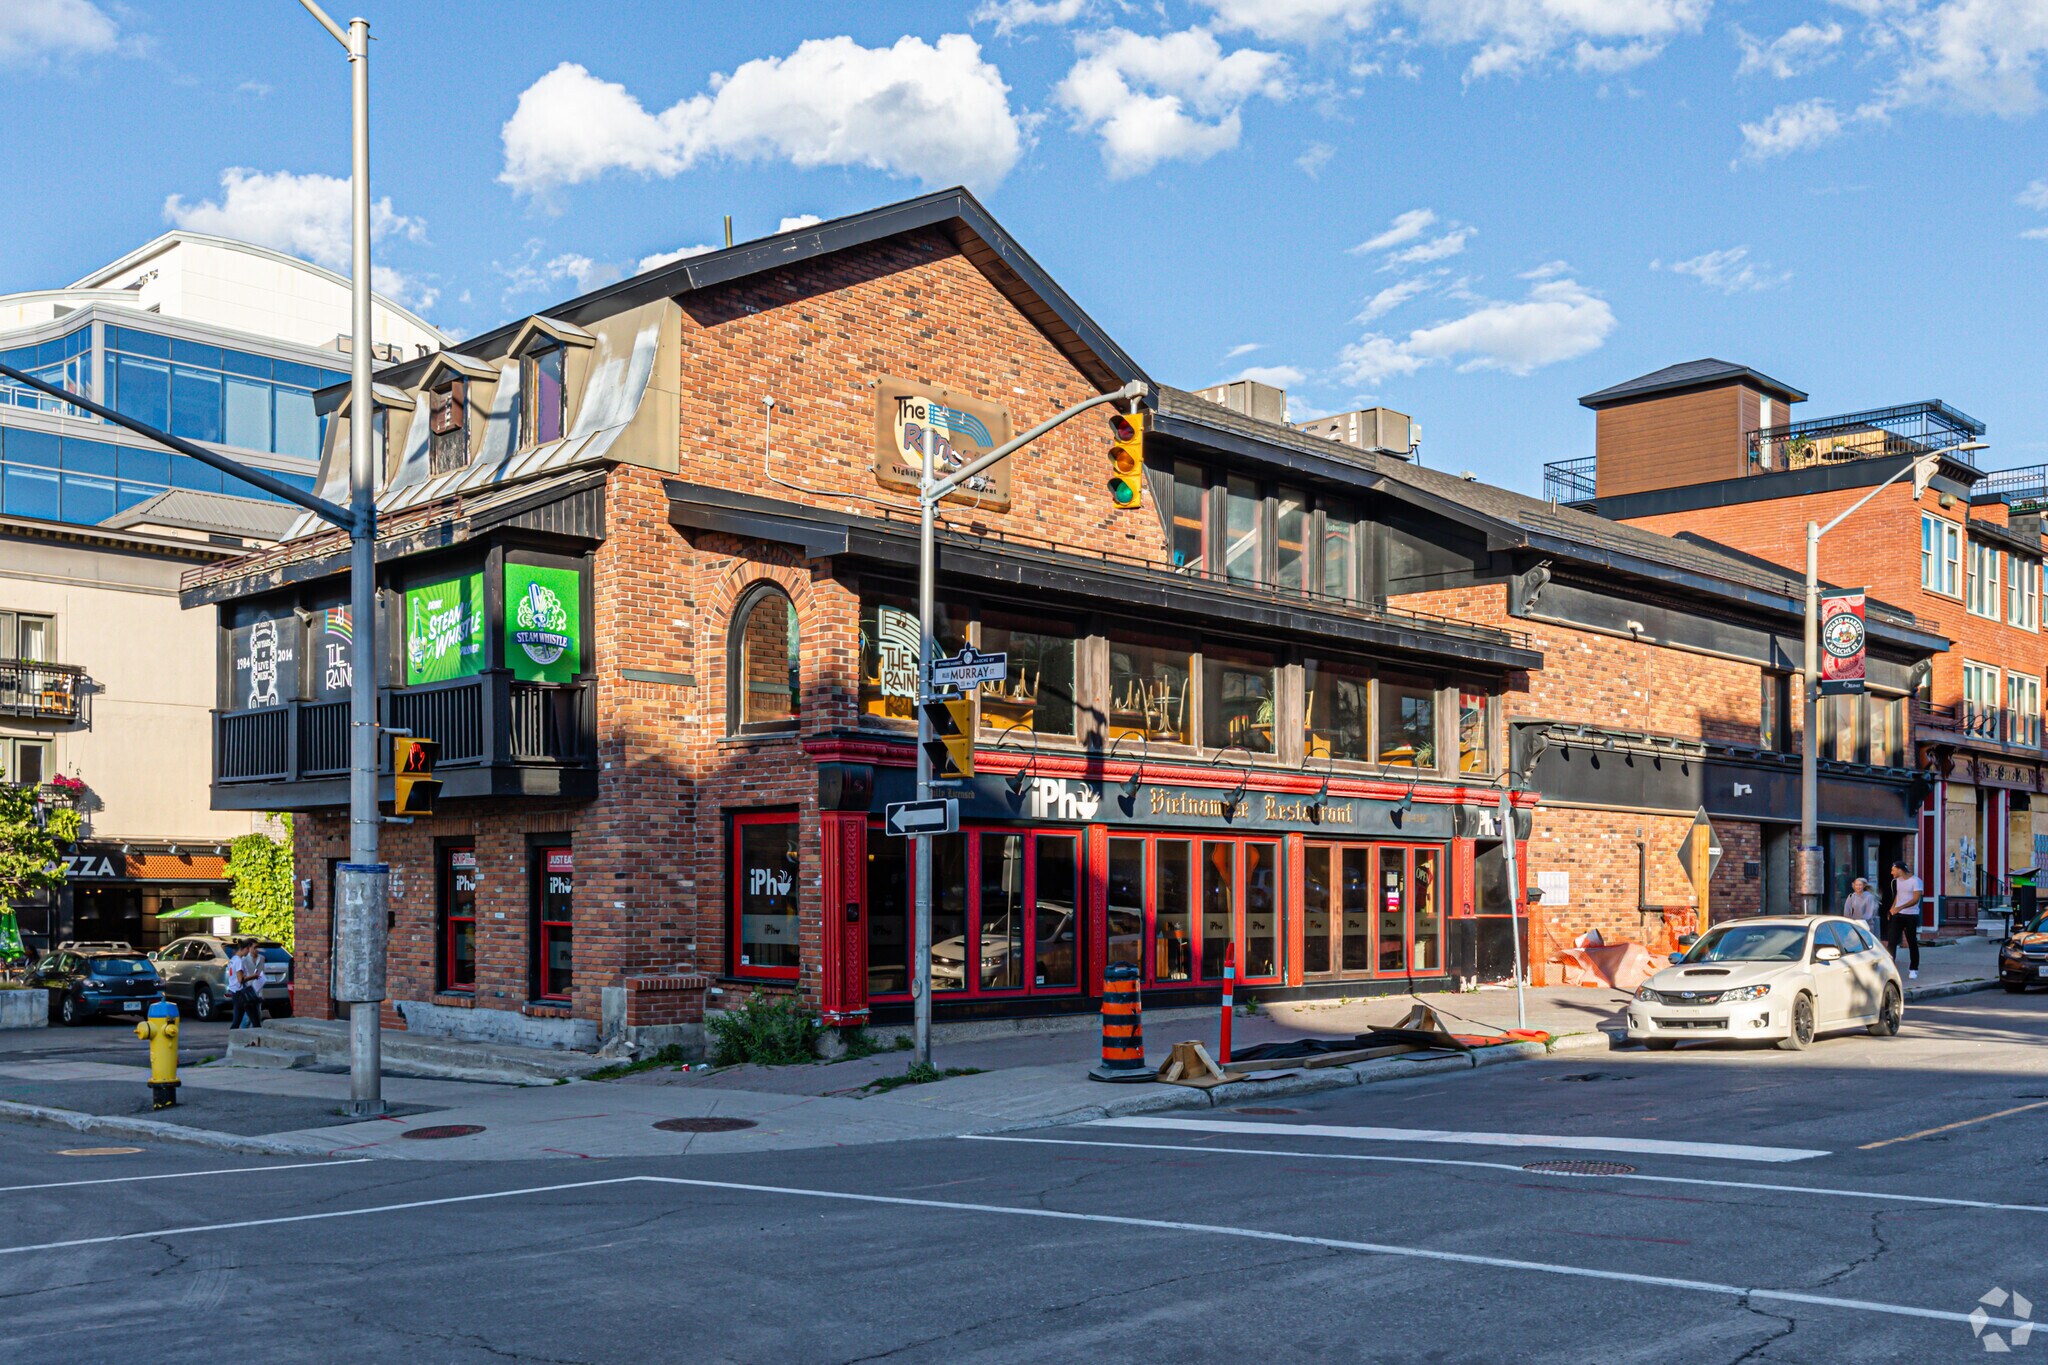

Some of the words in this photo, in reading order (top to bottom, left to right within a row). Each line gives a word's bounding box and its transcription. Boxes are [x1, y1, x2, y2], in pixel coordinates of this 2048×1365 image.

[894, 395, 926, 427] The
[428, 602, 464, 640] STEAM
[1826, 617, 1844, 637] BYWARD
[1844, 617, 1862, 634] MARKET
[435, 611, 481, 660] WHISTLE
[516, 631, 538, 643] STEAM
[539, 632, 568, 648] WHISTLE
[277, 648, 293, 662] 2014
[325, 643, 347, 667] THE
[1851, 643, 1859, 653] BY
[236, 658, 251, 670] 1984
[257, 661, 269, 671] LIVE
[882, 646, 911, 671] THE
[951, 666, 989, 680] MURRAY
[1150, 787, 1249, 819] Vietnamese
[1264, 794, 1353, 824] Restaurant
[550, 855, 564, 864] JUST
[1416, 867, 1429, 884] OPEN
